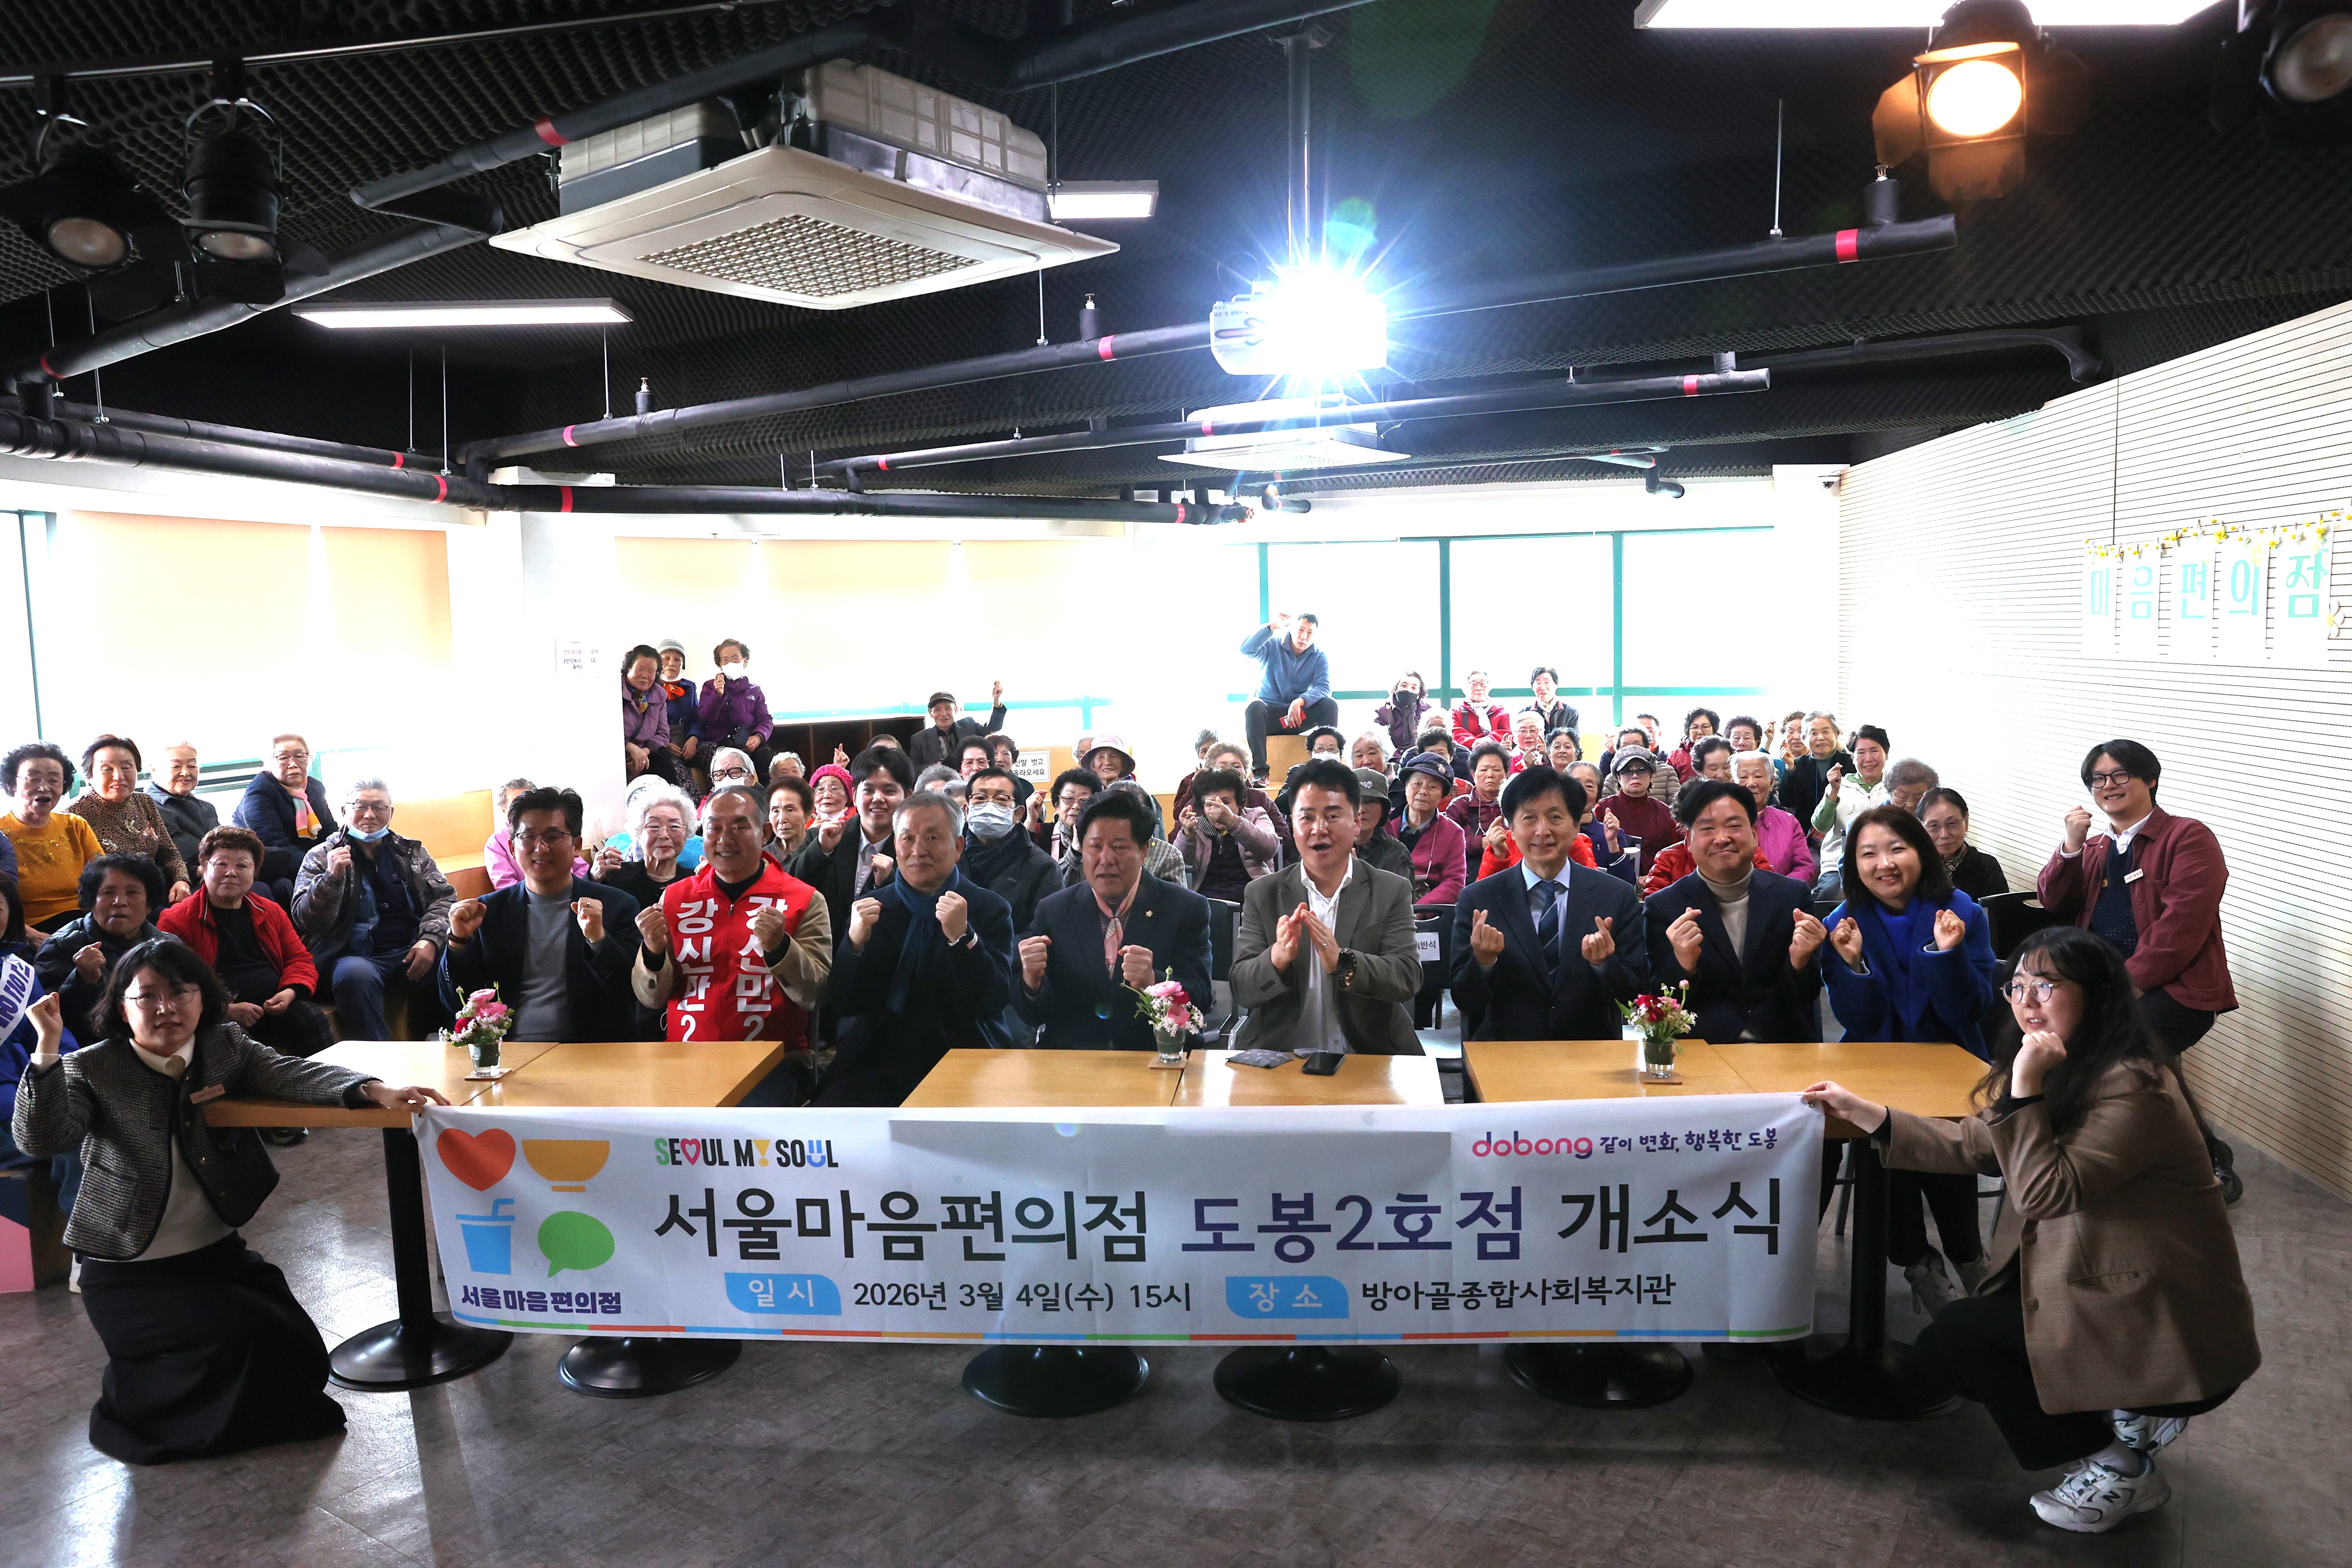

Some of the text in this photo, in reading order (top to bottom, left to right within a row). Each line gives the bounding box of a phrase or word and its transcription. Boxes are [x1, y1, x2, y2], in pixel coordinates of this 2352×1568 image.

[2091, 552, 2321, 619] 마음편의점
[1014, 769, 1045, 777] 올라오세요
[1418, 940, 1436, 950] 빈석
[680, 1014, 696, 1042] 2
[743, 1014, 764, 1041] 2
[775, 1139, 839, 1168] SOUL
[1473, 1131, 1593, 1160] dobong
[1599, 1128, 1778, 1154] 같이 변화, 행복한 도봉
[654, 1178, 1782, 1264] 서울마음편의점 도봉2호점 개소식
[460, 1285, 622, 1316] 서울마음편의점
[853, 1281, 1190, 1312] 2026년 3월 4일(수) 15시
[1362, 1274, 1676, 1311] 방아골종합사회복지관
